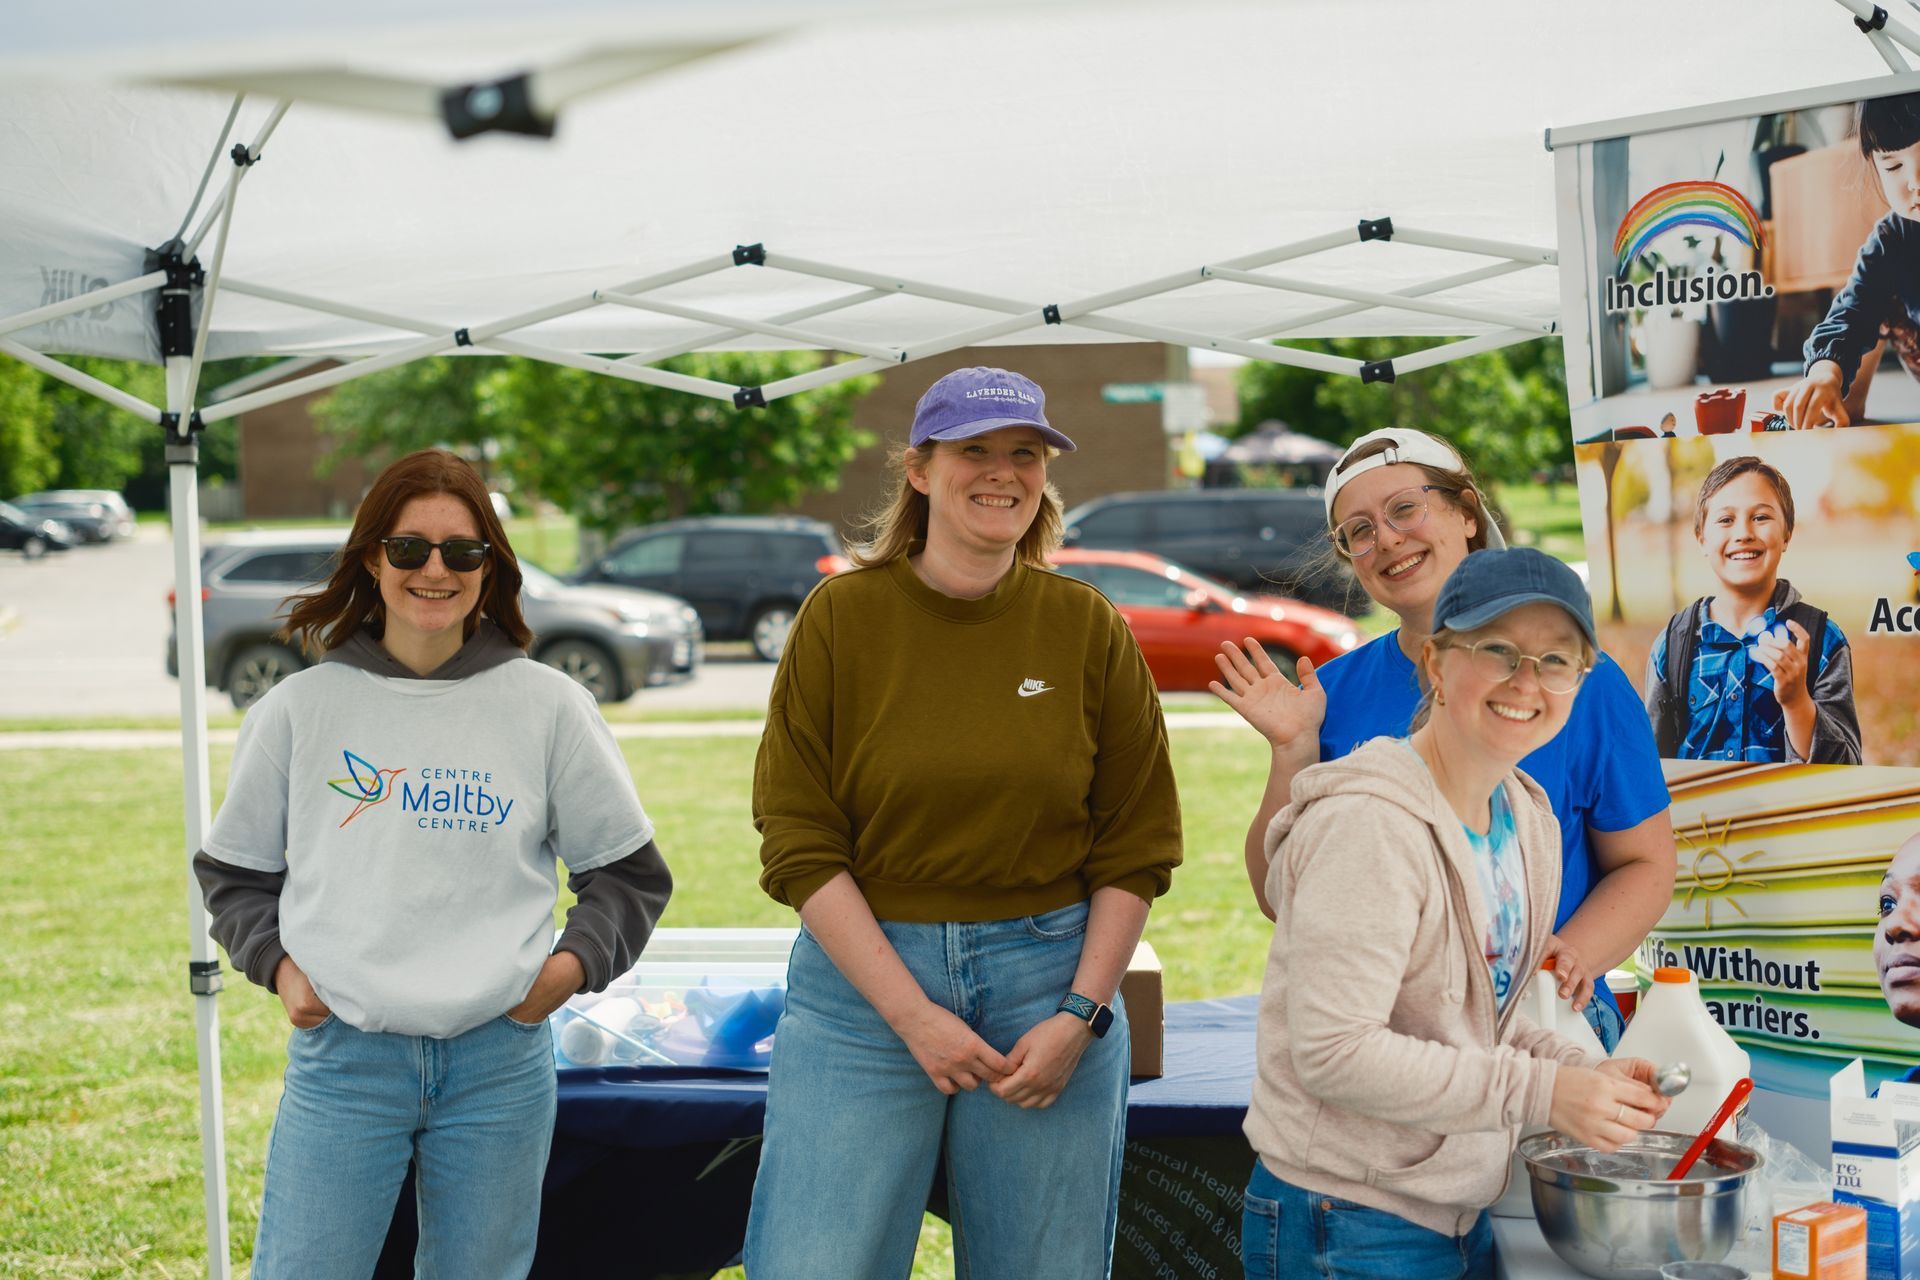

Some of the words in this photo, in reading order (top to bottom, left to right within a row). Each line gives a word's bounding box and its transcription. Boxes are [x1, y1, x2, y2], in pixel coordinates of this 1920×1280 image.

[1607, 266, 1774, 310] Inclusion.
[966, 387, 1016, 399] LAVENDER
[1023, 677, 1046, 691] NIKE
[421, 767, 492, 783] CENTRE
[402, 782, 514, 825] Maltby
[417, 817, 489, 833] CENTRE
[1683, 945, 1820, 991] Without
[1706, 996, 1820, 1039] arriers.
[1192, 1166, 1244, 1212] Health
[1836, 1174, 1862, 1188] nu
[1122, 1159, 1142, 1174] or
[1146, 1168, 1214, 1224] Children
[1211, 1217, 1225, 1236] &
[1222, 1225, 1243, 1261] You
[1118, 1218, 1160, 1266] utisme
[1169, 1229, 1186, 1251] de
[1183, 1246, 1219, 1280] santé
